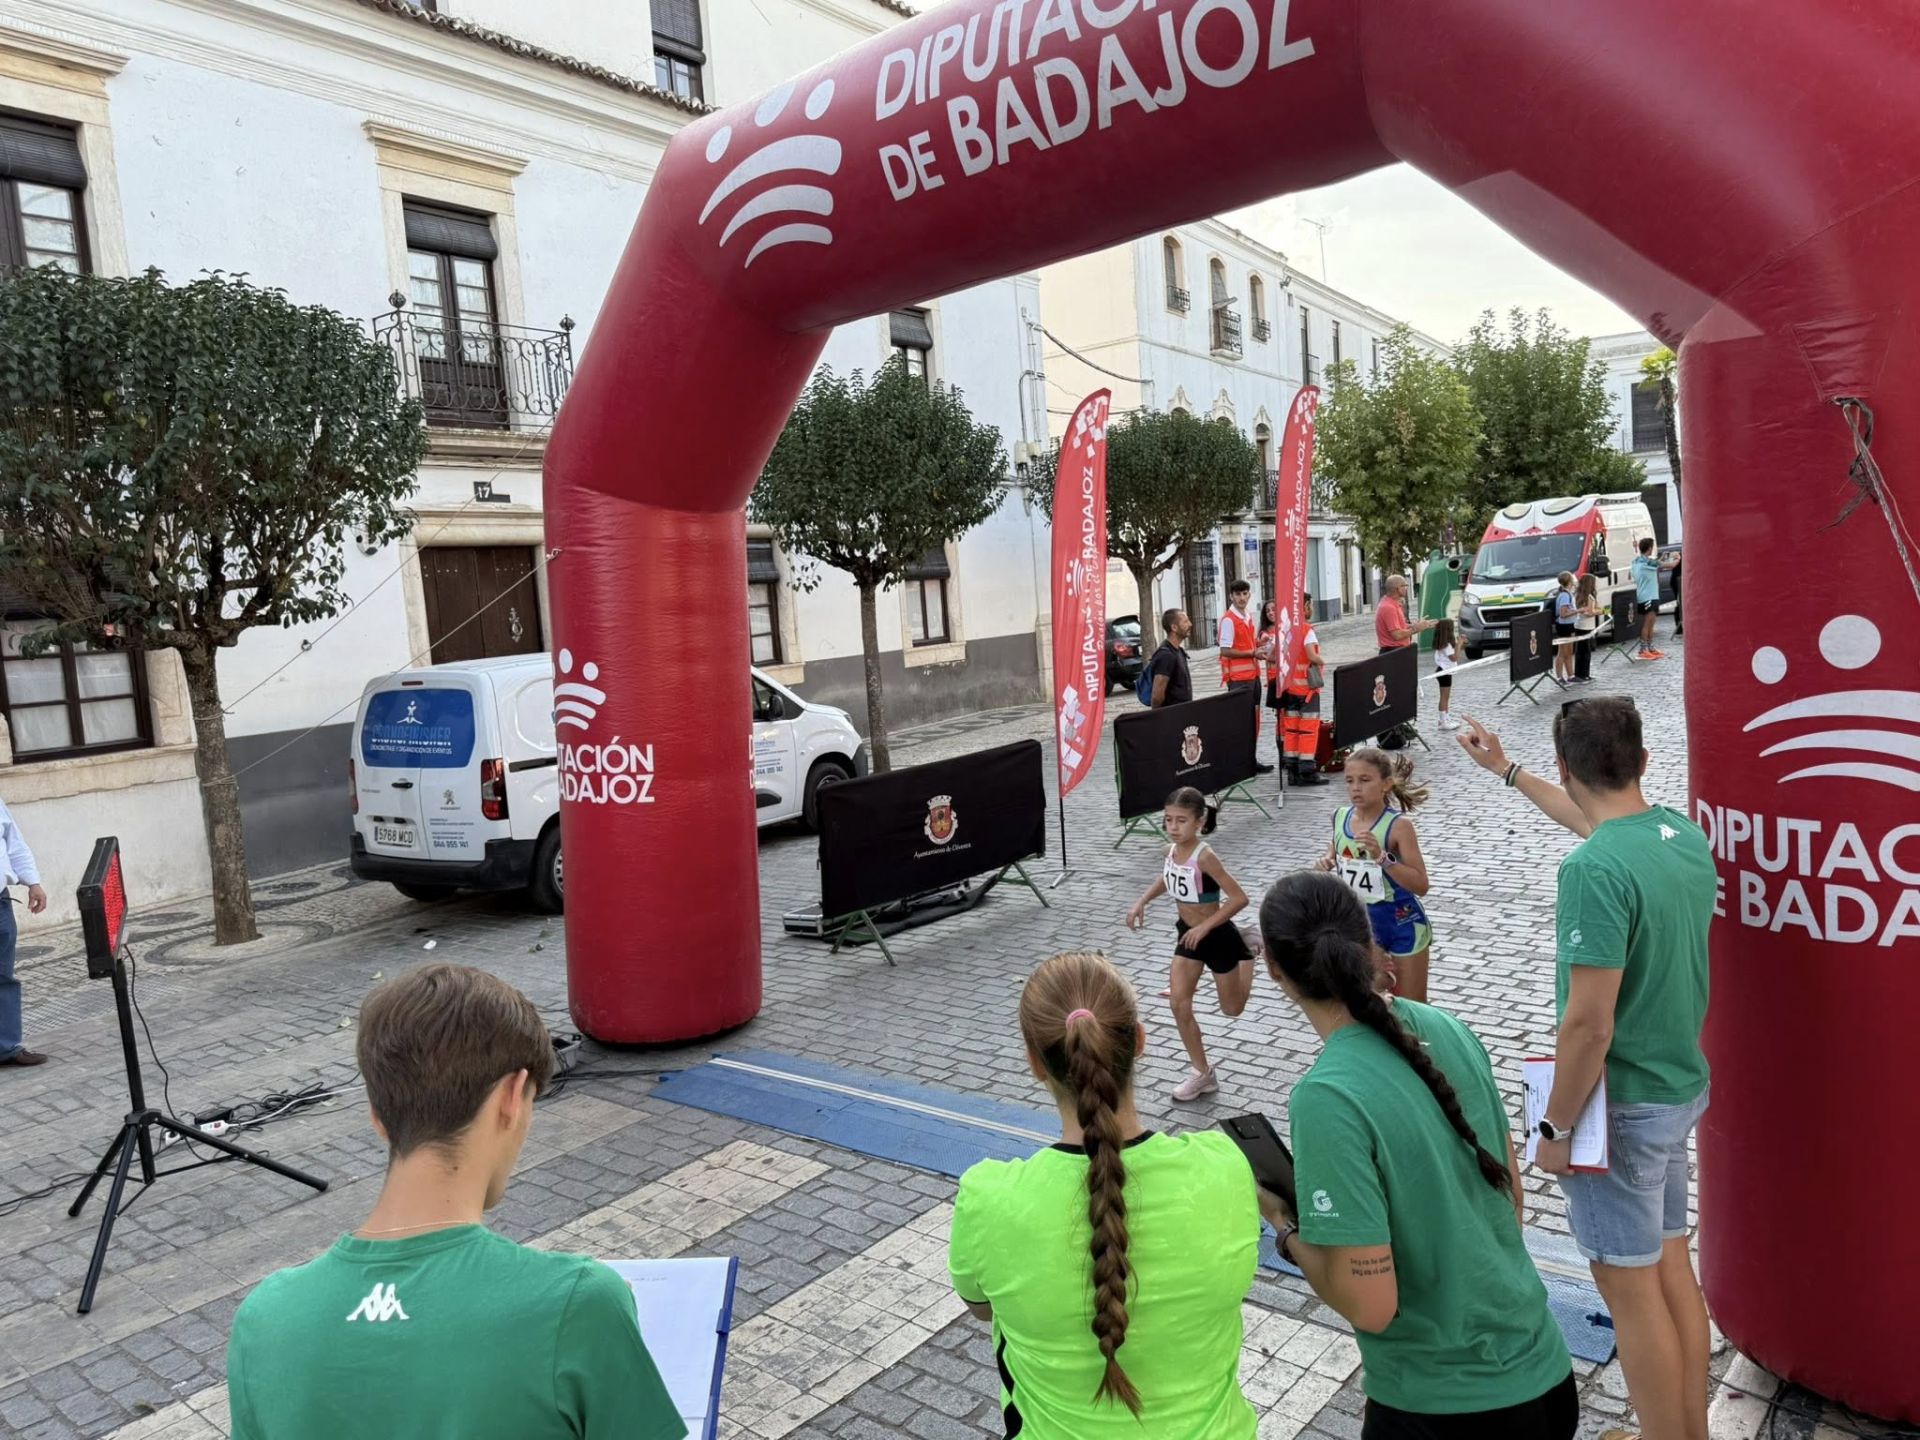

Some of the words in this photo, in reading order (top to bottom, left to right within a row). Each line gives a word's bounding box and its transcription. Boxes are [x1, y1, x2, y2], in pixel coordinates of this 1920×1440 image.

[876, 0, 1158, 121] DIPUTA
[879, 130, 945, 202] DE
[946, 0, 1316, 177] BADAJOZ
[478, 486, 490, 498] 17
[1082, 466, 1097, 559] BADAJOZ
[1295, 439, 1307, 513] BADAJOZ
[557, 735, 655, 774] TACIÓN
[1165, 870, 1189, 897] 175
